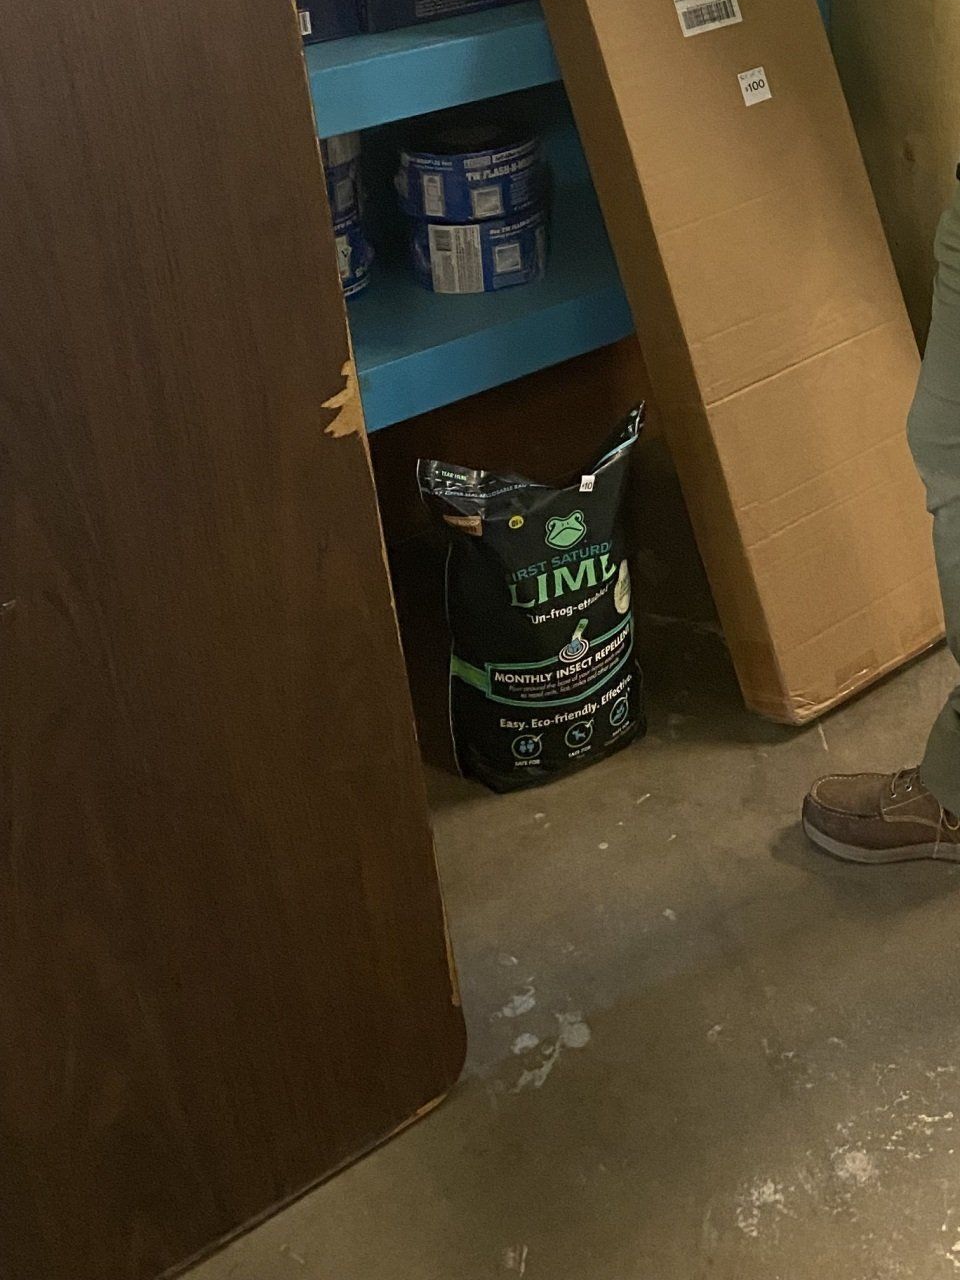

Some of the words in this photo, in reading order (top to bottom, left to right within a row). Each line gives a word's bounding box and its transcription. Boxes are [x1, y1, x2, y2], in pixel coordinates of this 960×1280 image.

[744, 79, 765, 93] $100
[511, 561, 548, 582] IRST
[494, 671, 553, 685] MONTHLY
[556, 656, 593, 679] INSECT
[500, 718, 529, 731] Easy.
[531, 702, 600, 729] Eco-friendly.
